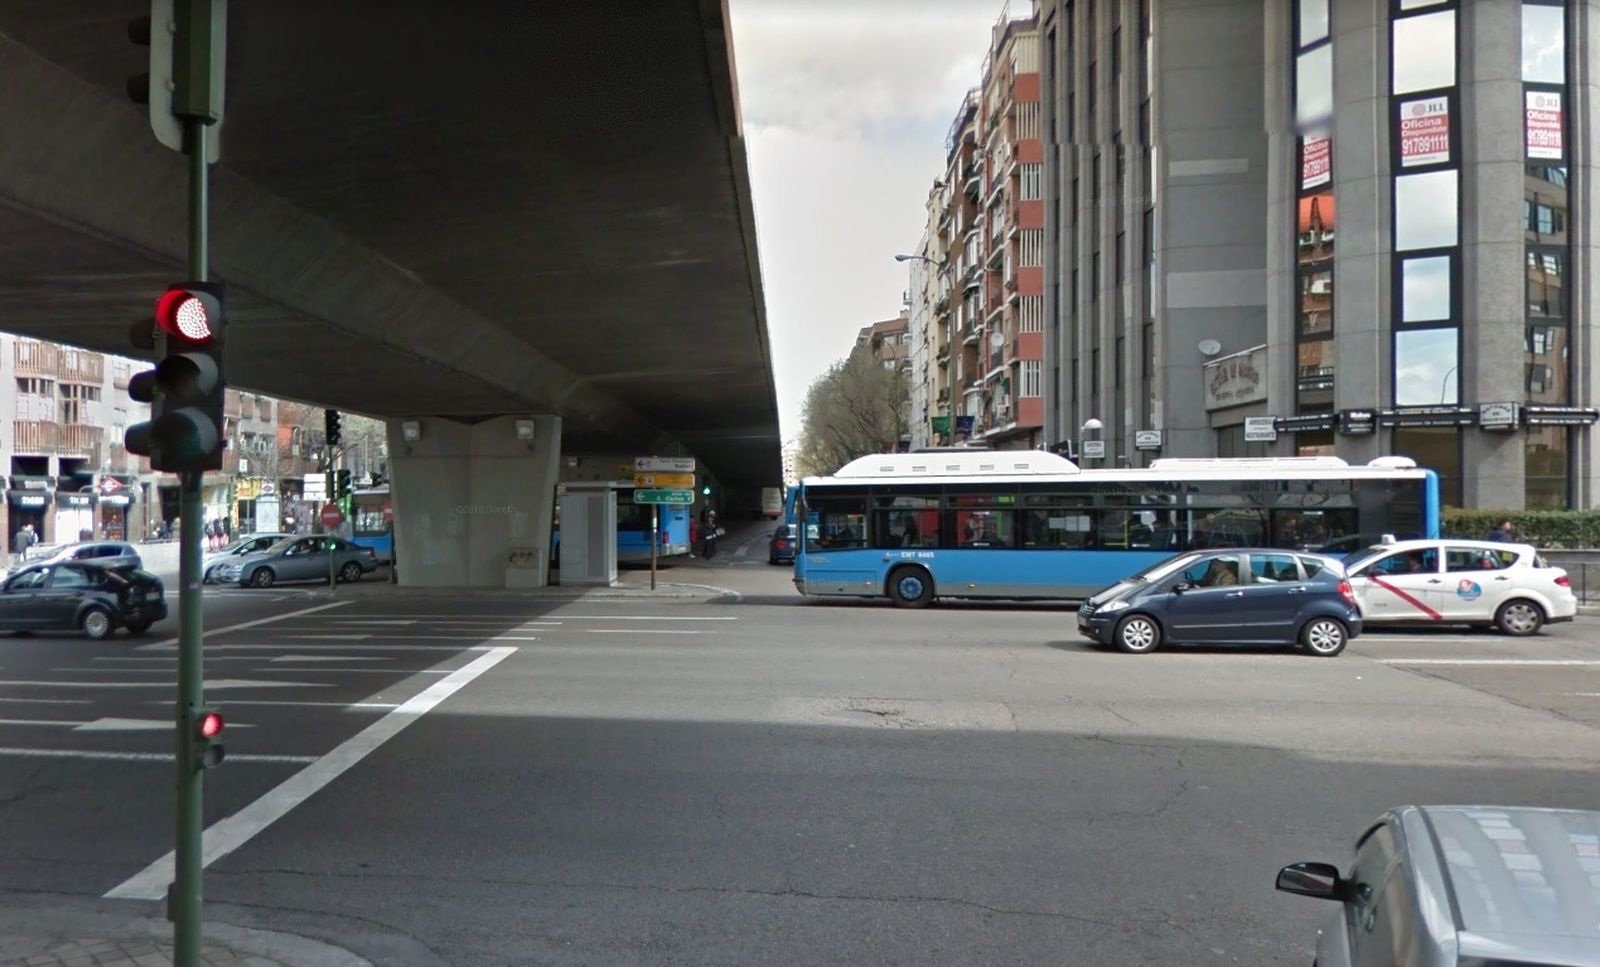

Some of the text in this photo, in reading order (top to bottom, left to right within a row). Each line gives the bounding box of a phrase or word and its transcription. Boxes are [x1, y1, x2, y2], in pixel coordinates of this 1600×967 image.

[1428, 103, 1444, 113] JLL
[1401, 117, 1442, 130] Oficina
[1402, 133, 1449, 155] 917891111
[900, 551, 915, 559] EMT
